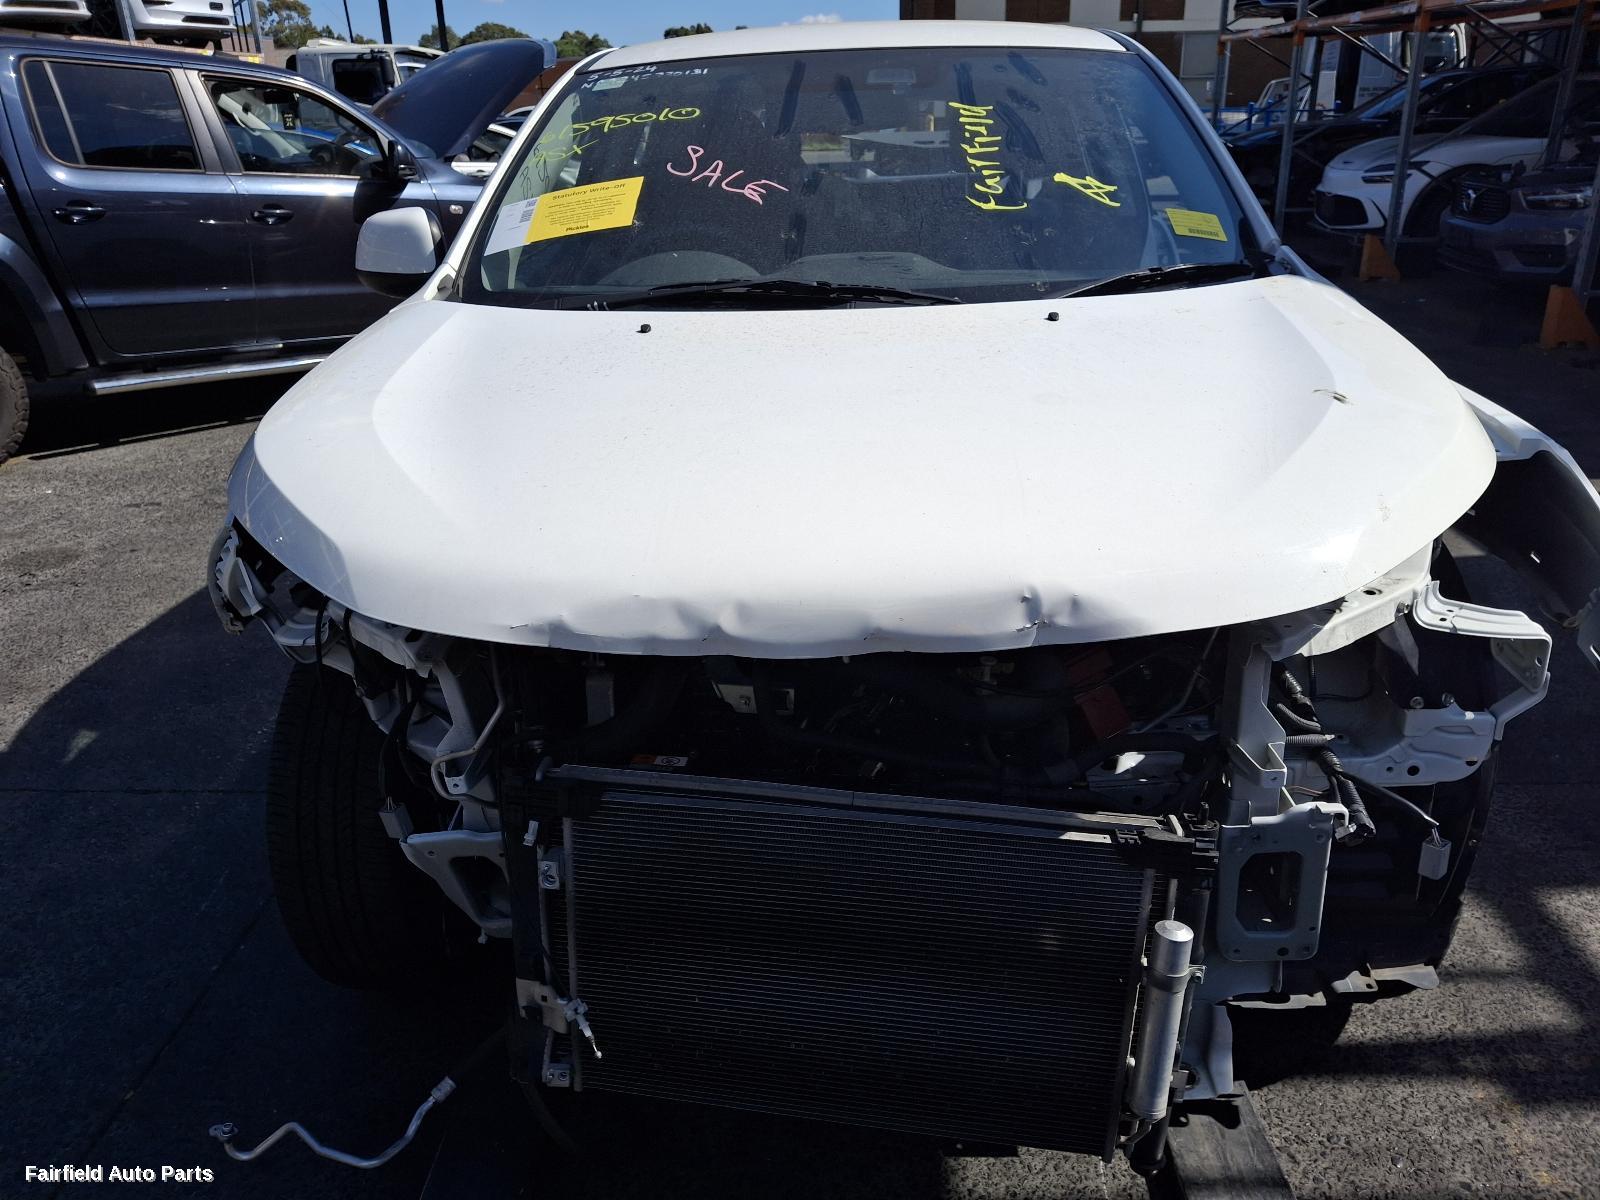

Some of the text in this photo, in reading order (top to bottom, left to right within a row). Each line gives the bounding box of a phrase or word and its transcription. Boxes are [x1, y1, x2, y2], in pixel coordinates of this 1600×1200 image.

[552, 182, 627, 201] Statutory Write-Off
[666, 145, 789, 205] SALE
